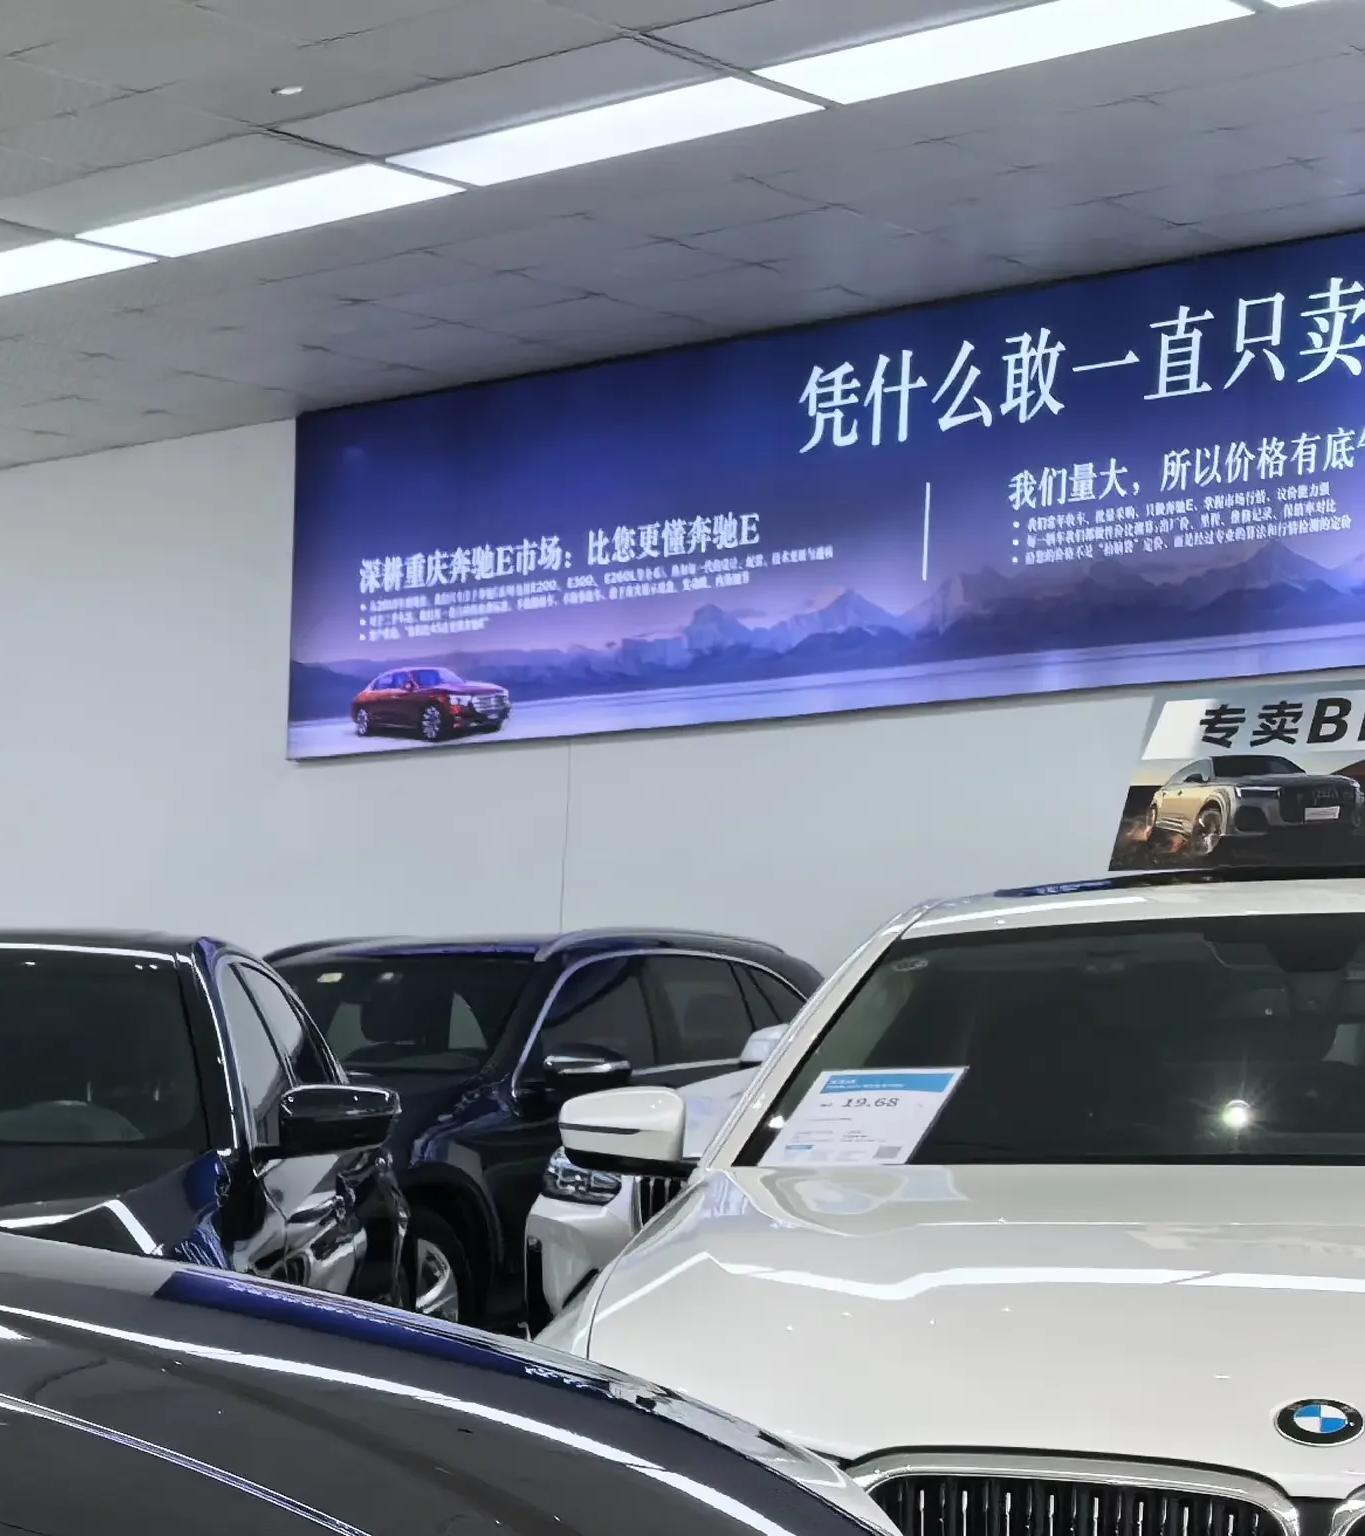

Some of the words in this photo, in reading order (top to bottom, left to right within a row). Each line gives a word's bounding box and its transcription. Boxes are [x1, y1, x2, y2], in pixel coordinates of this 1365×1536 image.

[799, 276, 1365, 453] 凭什么敢一直只卖
[1008, 425, 1365, 511] 我们量大，所以价格有底
[1199, 697, 1365, 749] 专卖B
